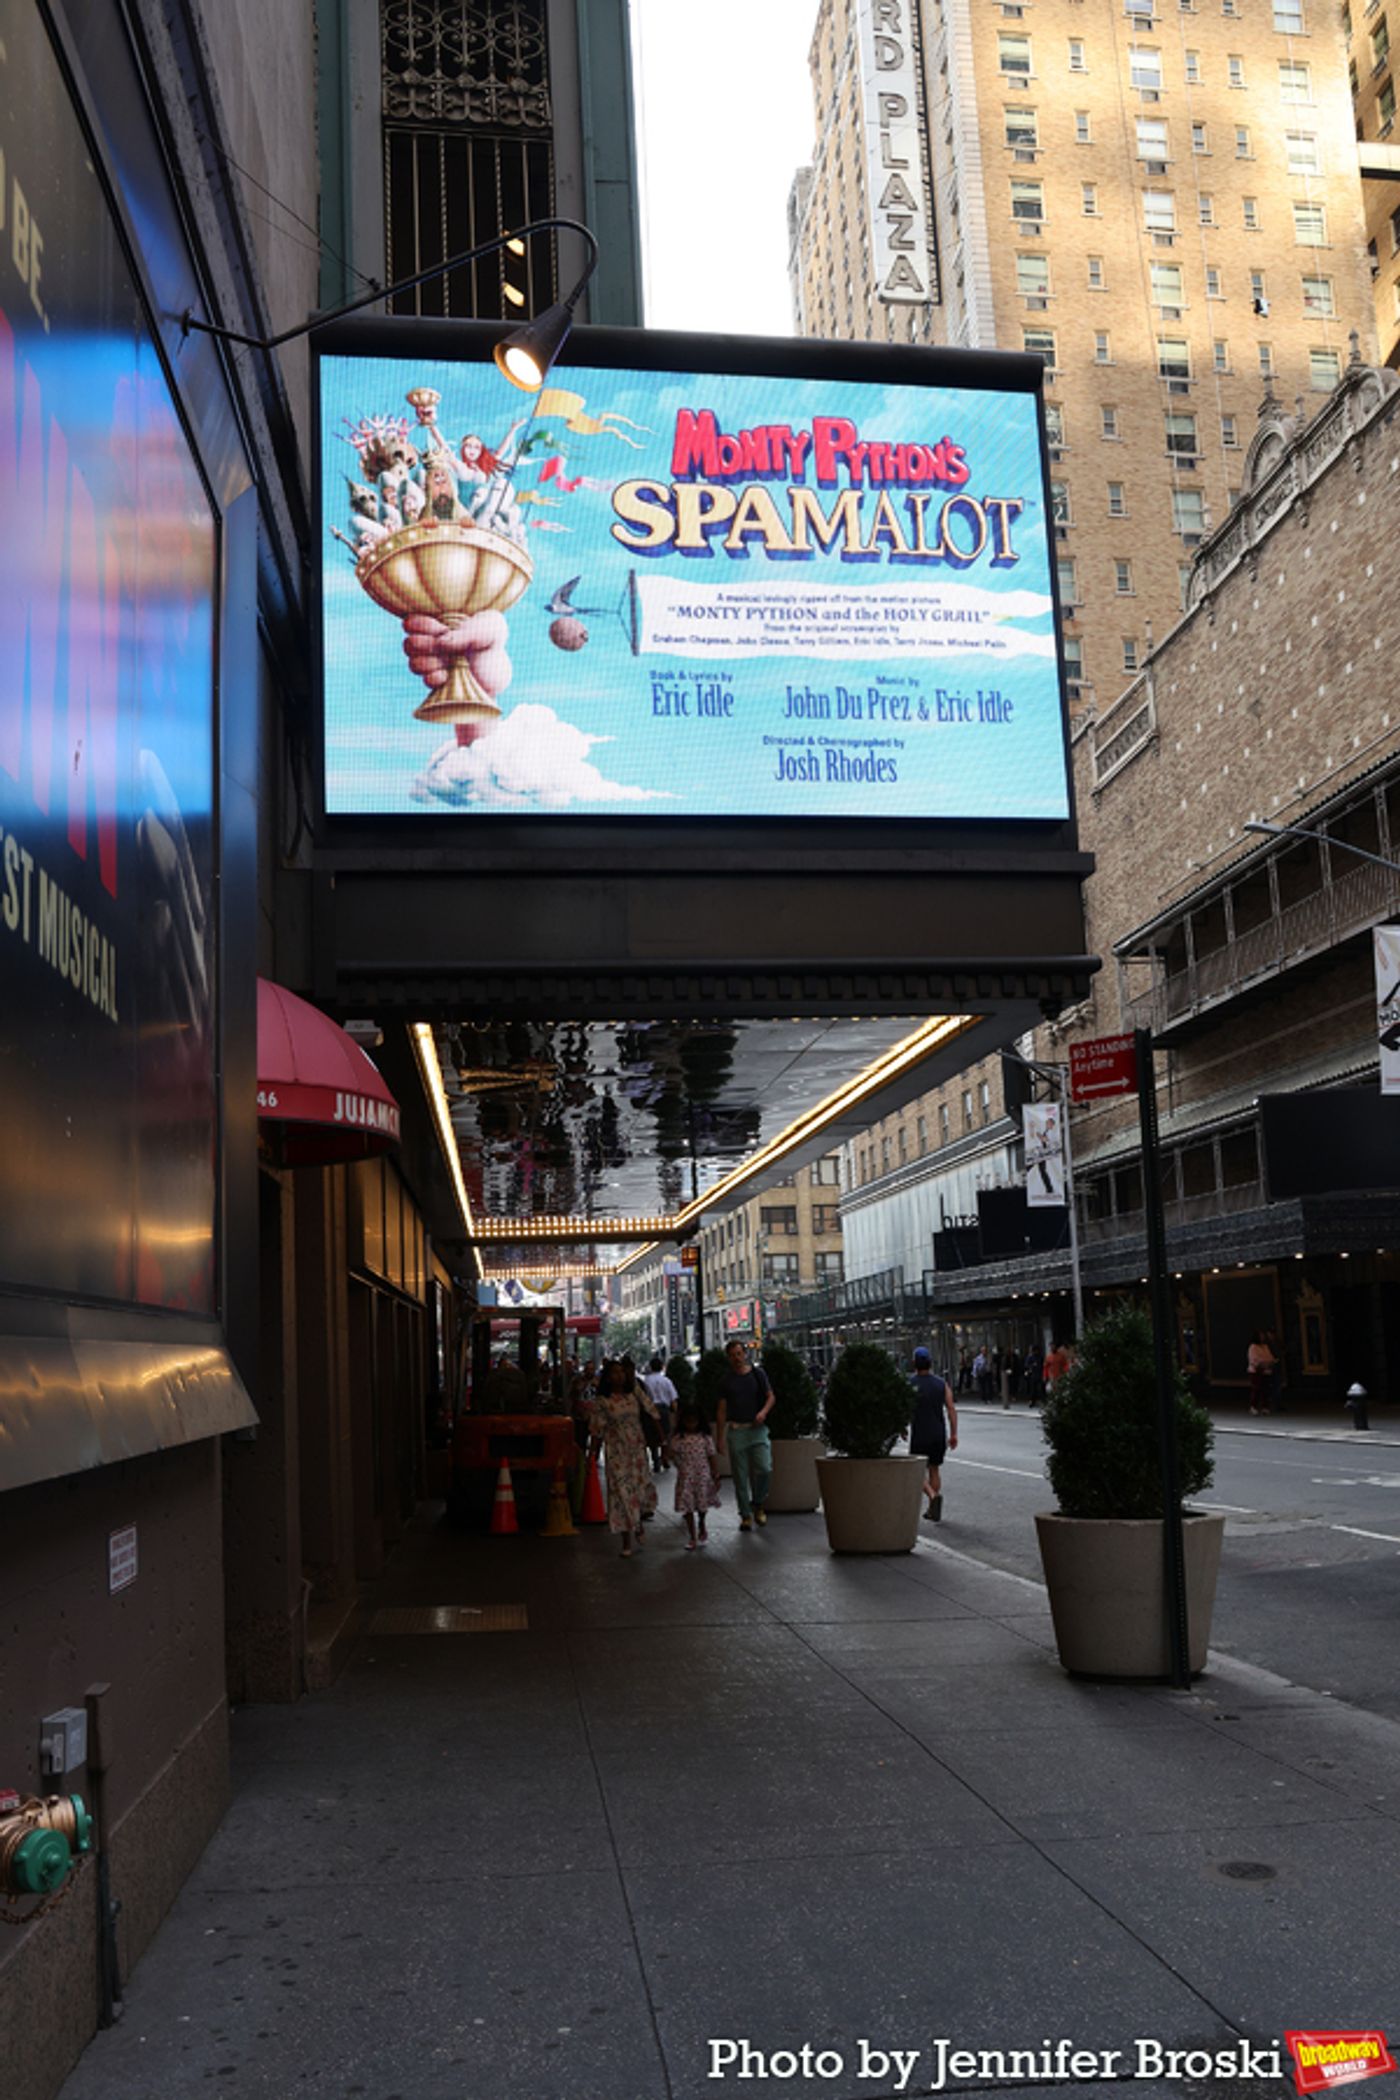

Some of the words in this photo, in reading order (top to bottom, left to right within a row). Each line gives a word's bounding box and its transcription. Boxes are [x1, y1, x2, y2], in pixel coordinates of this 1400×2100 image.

[877, 92, 924, 293] PLAZA
[611, 479, 1023, 569] SPAMALOT
[746, 607, 818, 620] PYTHON
[821, 608, 851, 620] and
[855, 608, 880, 621] the
[884, 609, 928, 622] HOLY
[649, 670, 675, 680] Book
[679, 670, 687, 680] &
[689, 671, 719, 682] Lyrics
[721, 671, 733, 683] by
[908, 677, 919, 688] by
[652, 682, 691, 716] Eric
[696, 683, 734, 717] Idle
[782, 685, 831, 719] John
[835, 686, 862, 719] Du
[867, 687, 911, 721] Prez
[917, 696, 929, 721] &
[935, 689, 972, 722] Eric
[976, 690, 1014, 723] Idle
[763, 735, 805, 746] Directed
[807, 736, 815, 746] &
[817, 737, 891, 749] Choreographed
[894, 738, 905, 749] by
[774, 748, 820, 782] Josh
[825, 749, 898, 783] Rhodes
[0, 825, 34, 944] ST
[39, 867, 118, 1024] MUSICAL
[1073, 1046, 1086, 1059] NO
[1074, 1057, 1115, 1074] Anytime
